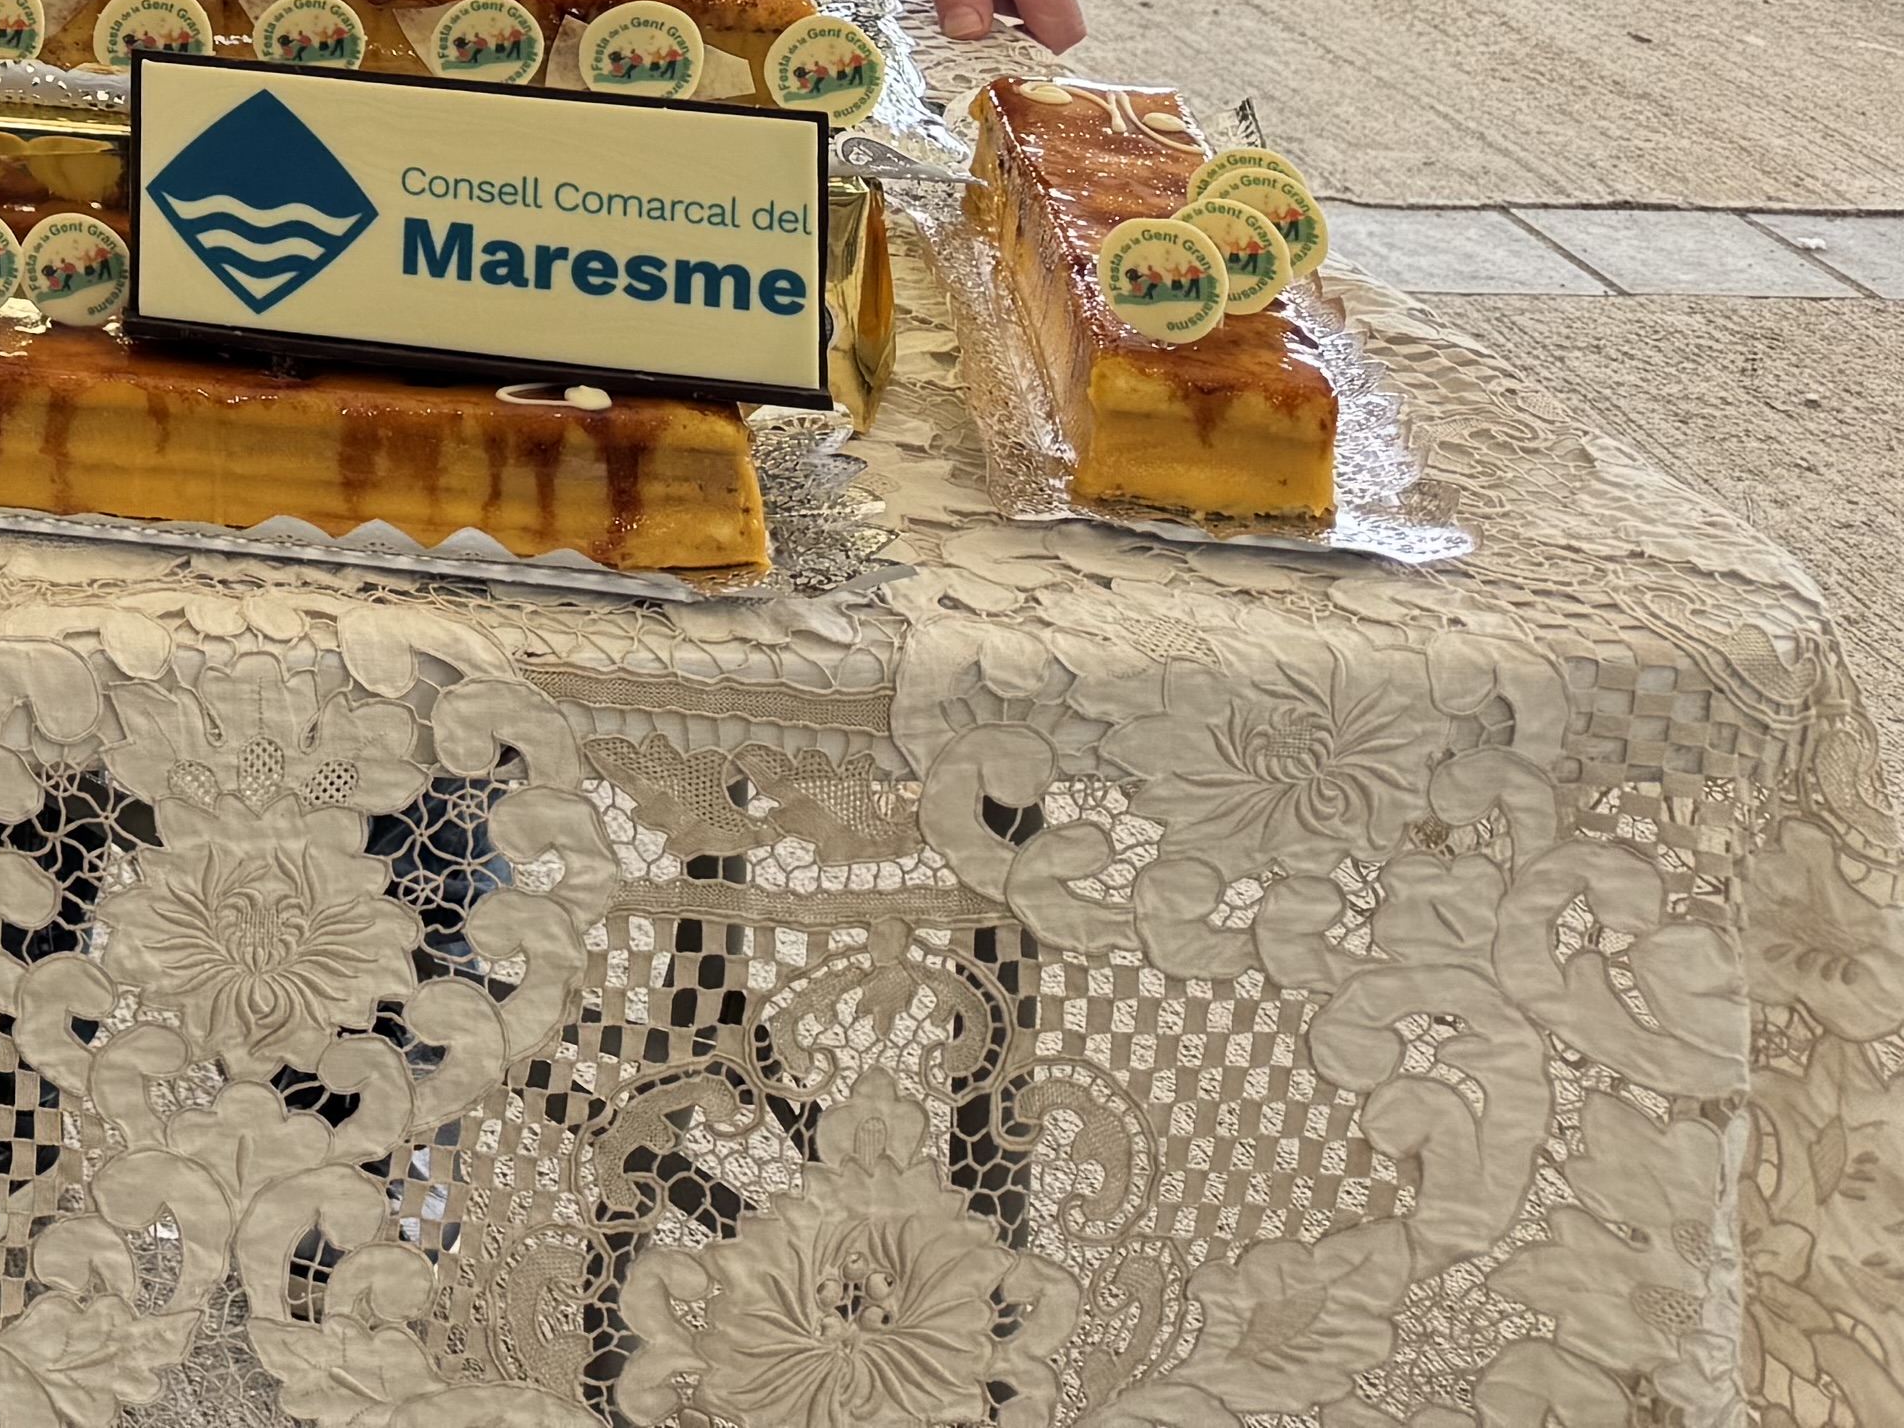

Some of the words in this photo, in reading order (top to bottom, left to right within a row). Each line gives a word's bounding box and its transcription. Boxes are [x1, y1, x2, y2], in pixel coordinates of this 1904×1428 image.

[400, 165, 544, 210] Consell
[554, 181, 742, 229] Comarcal
[752, 199, 813, 236] del
[1140, 228, 1179, 245] Gent
[1182, 239, 1212, 271] Gran
[402, 216, 808, 317] Maresme
[1108, 253, 1123, 292] Festa
[1166, 293, 1220, 332] Maresme
